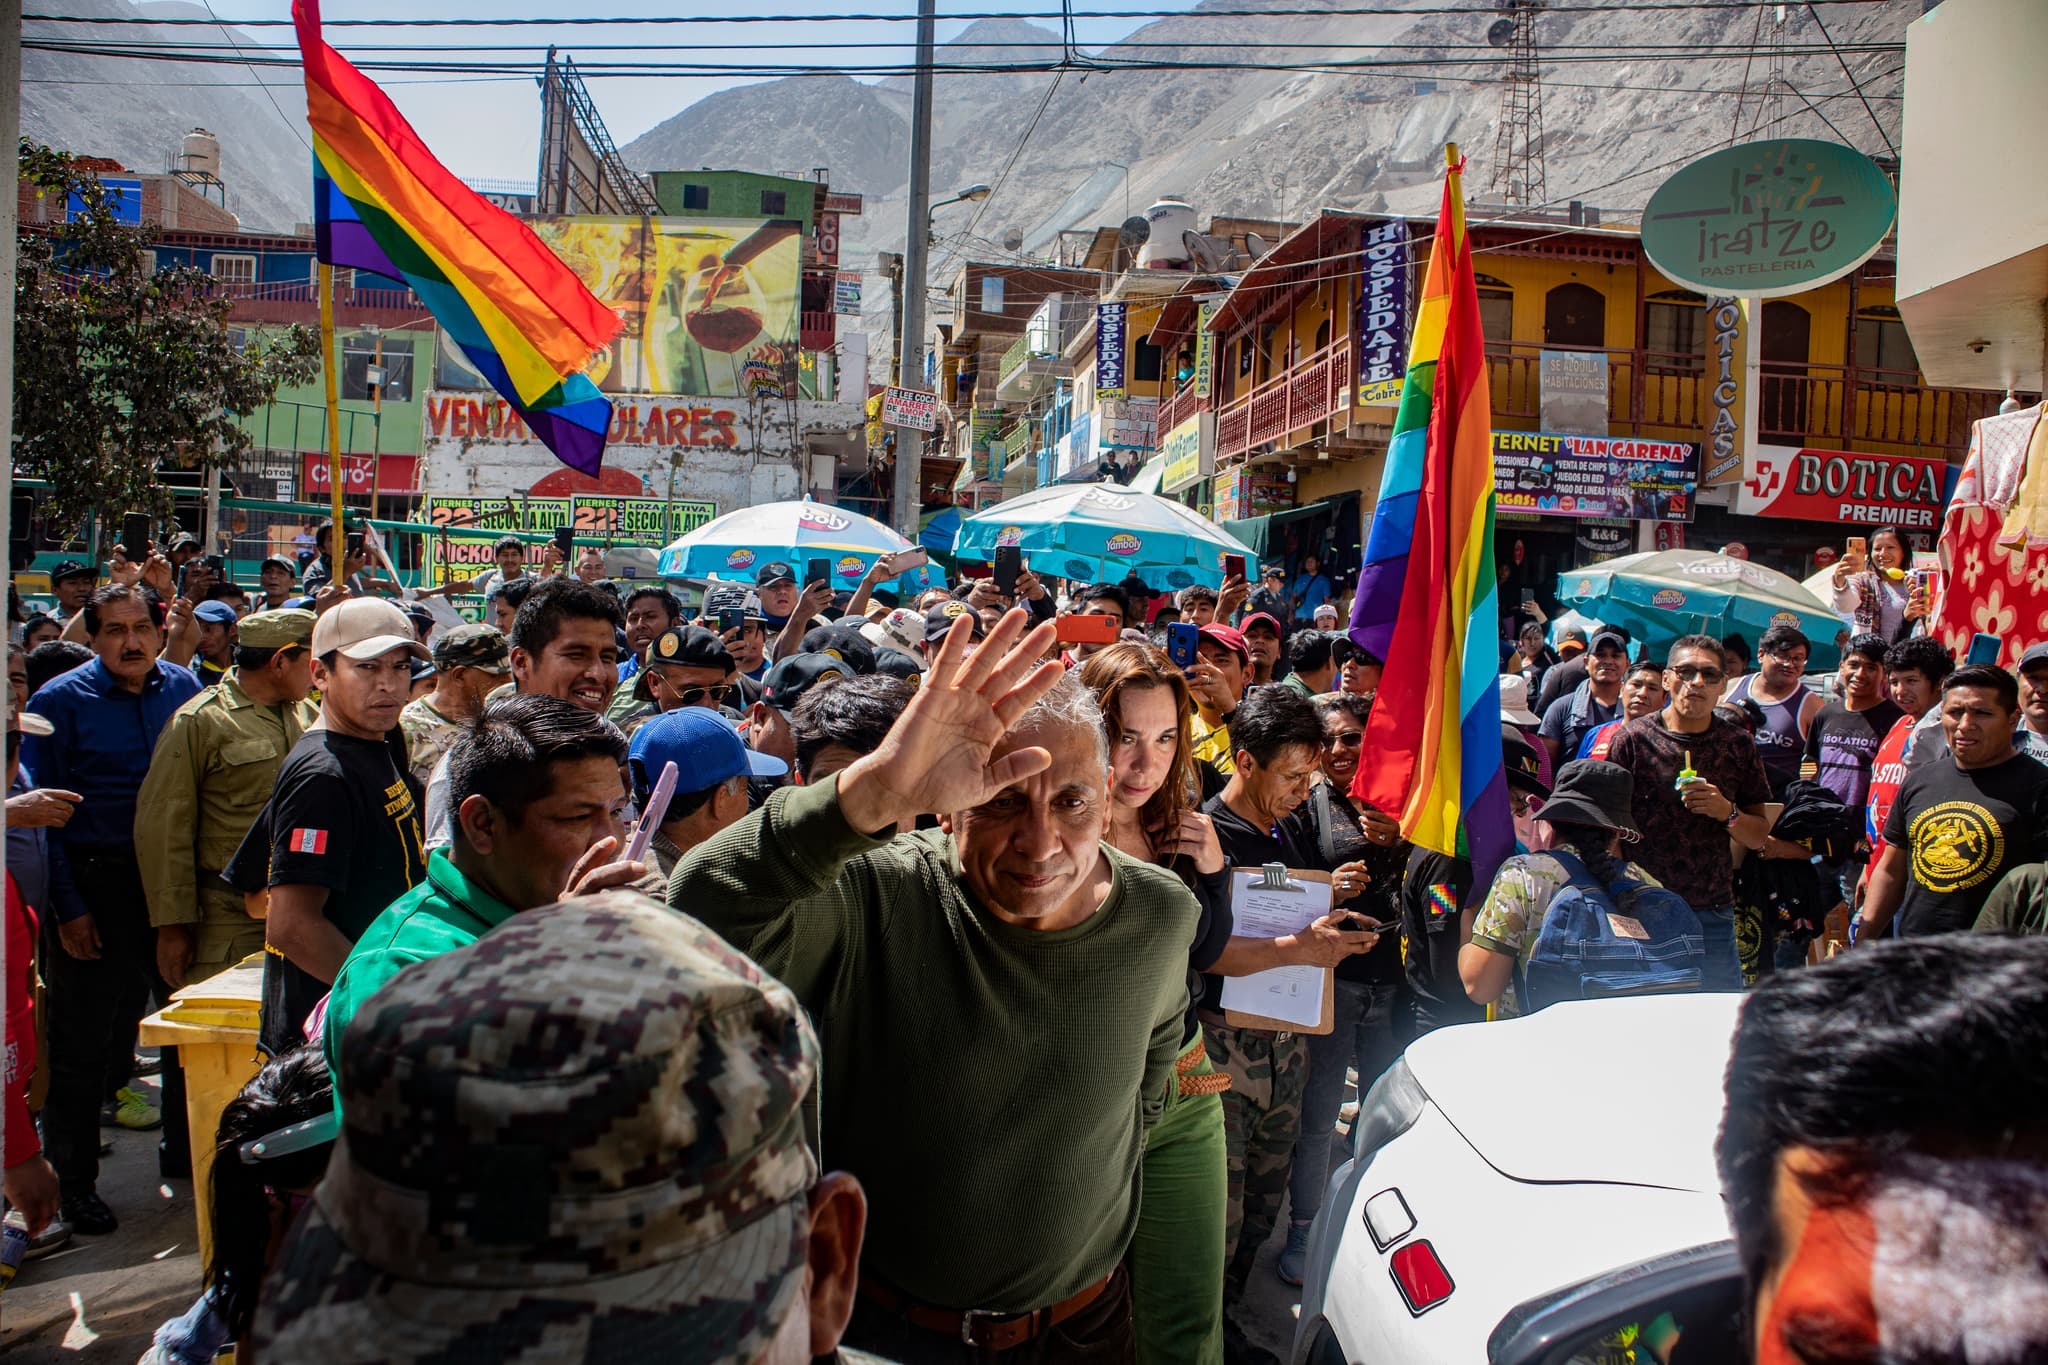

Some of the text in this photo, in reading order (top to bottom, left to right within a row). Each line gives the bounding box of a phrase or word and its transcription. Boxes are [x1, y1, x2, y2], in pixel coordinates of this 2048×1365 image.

[1701, 259, 1815, 277] PASTELERIA
[1367, 223, 1397, 383] HOSPEDAJE
[1101, 304, 1120, 388] HOSPEDAJE
[1550, 360, 1598, 373] SE ALQUILA
[1544, 375, 1605, 390] HABITACIONES
[888, 389, 935, 404] SE LEE COCA
[887, 404, 897, 412] DE
[900, 407, 924, 417] AMOR
[605, 404, 739, 448] ULARES
[1490, 433, 1563, 453] TERNET
[1494, 455, 1530, 467] PRESIONES
[1578, 461, 1588, 470] DE
[1588, 462, 1607, 472] CHIPS
[1704, 454, 1741, 481] PREMIER
[311, 462, 366, 484] Clro
[1494, 468, 1515, 478] ANEOS
[1582, 473, 1591, 483] EN
[1591, 475, 1605, 485] RED
[1795, 454, 1940, 505] BOTICA
[1574, 486, 1583, 495] DE
[433, 499, 473, 508] VIERNES
[576, 499, 617, 507] VIERNES
[628, 503, 660, 511] LOZA
[1495, 493, 1536, 506] RGAS:
[541, 512, 566, 530] ALTA
[574, 506, 618, 530] 22
[800, 508, 849, 530] boly
[1839, 503, 1933, 526] PREMIER
[1591, 528, 1619, 541] K&G
[1106, 537, 1142, 552] Yamboly
[726, 551, 757, 567] Yamboly
[835, 559, 866, 575] Yamboly
[1652, 593, 1687, 606] Yamboly
[1823, 734, 1879, 748] ISOLATION
